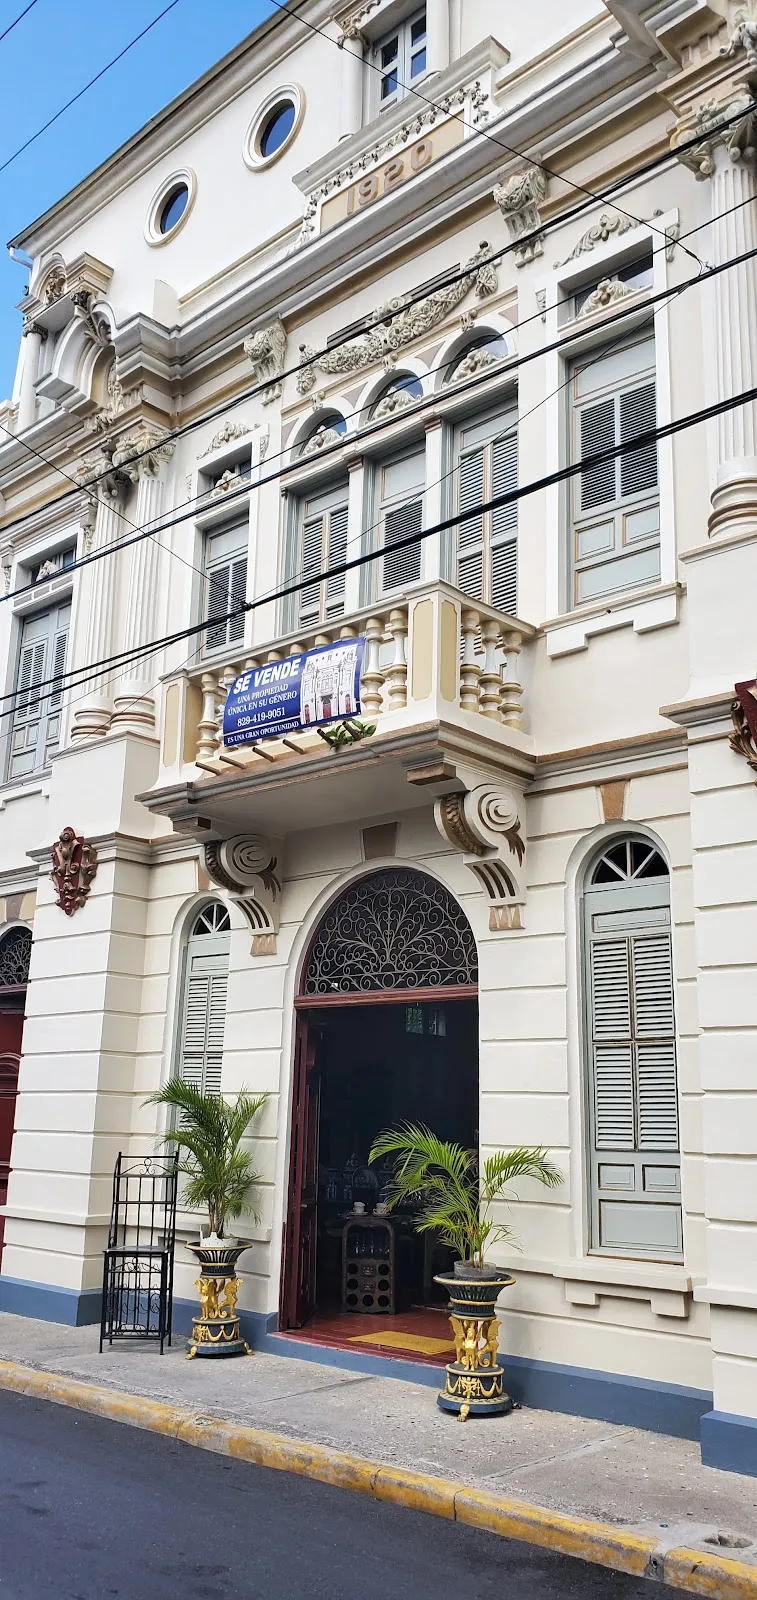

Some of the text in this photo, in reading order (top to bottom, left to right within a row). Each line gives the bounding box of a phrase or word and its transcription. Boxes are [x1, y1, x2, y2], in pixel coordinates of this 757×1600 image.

[347, 138, 433, 216] 1920
[233, 658, 302, 694] SE VENDE
[227, 690, 298, 716] ÚNICA EN SU GÉNERO
[237, 683, 289, 704] UNA PROPIEDAD
[237, 707, 286, 727] 829-419-9051
[234, 733, 245, 742] UNA
[245, 730, 260, 739] GRAN
[260, 720, 299, 735] OPORTUNIDAD
